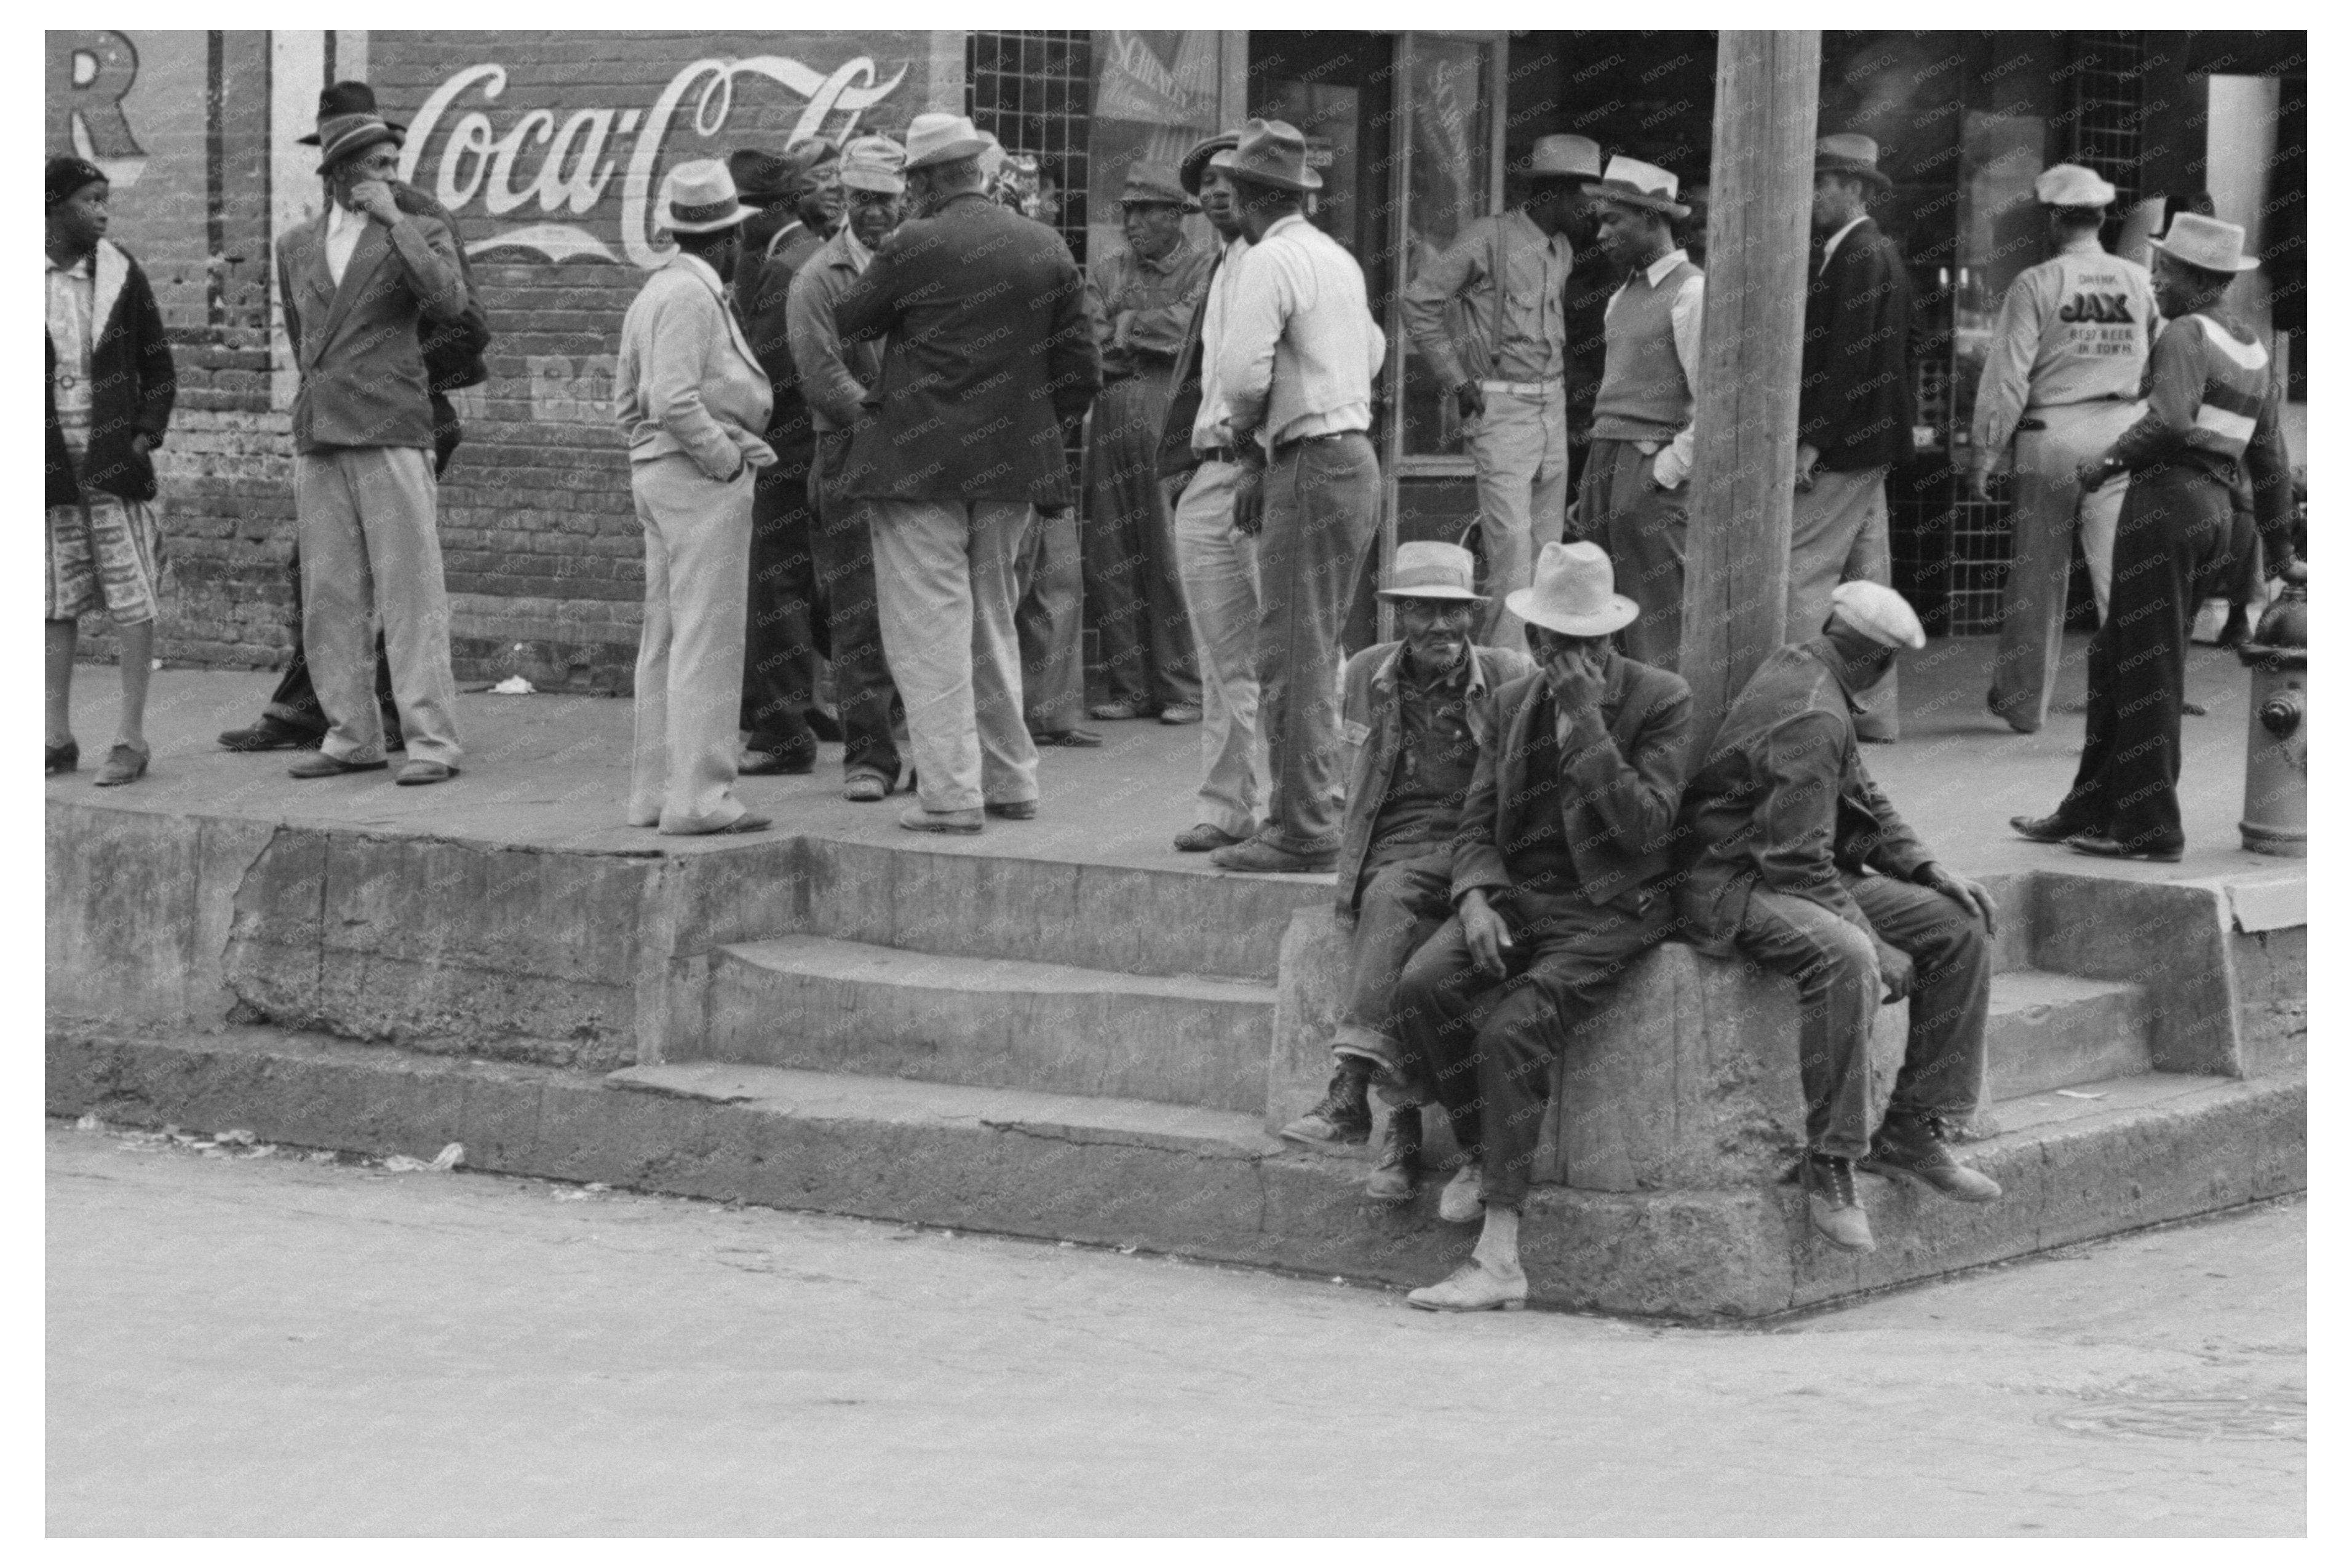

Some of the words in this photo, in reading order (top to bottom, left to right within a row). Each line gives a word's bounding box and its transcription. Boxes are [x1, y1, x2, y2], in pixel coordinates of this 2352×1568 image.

[2060, 292, 2135, 324] JAX
[2100, 329, 2133, 341] BEER
[2096, 343, 2132, 355] TOWN
